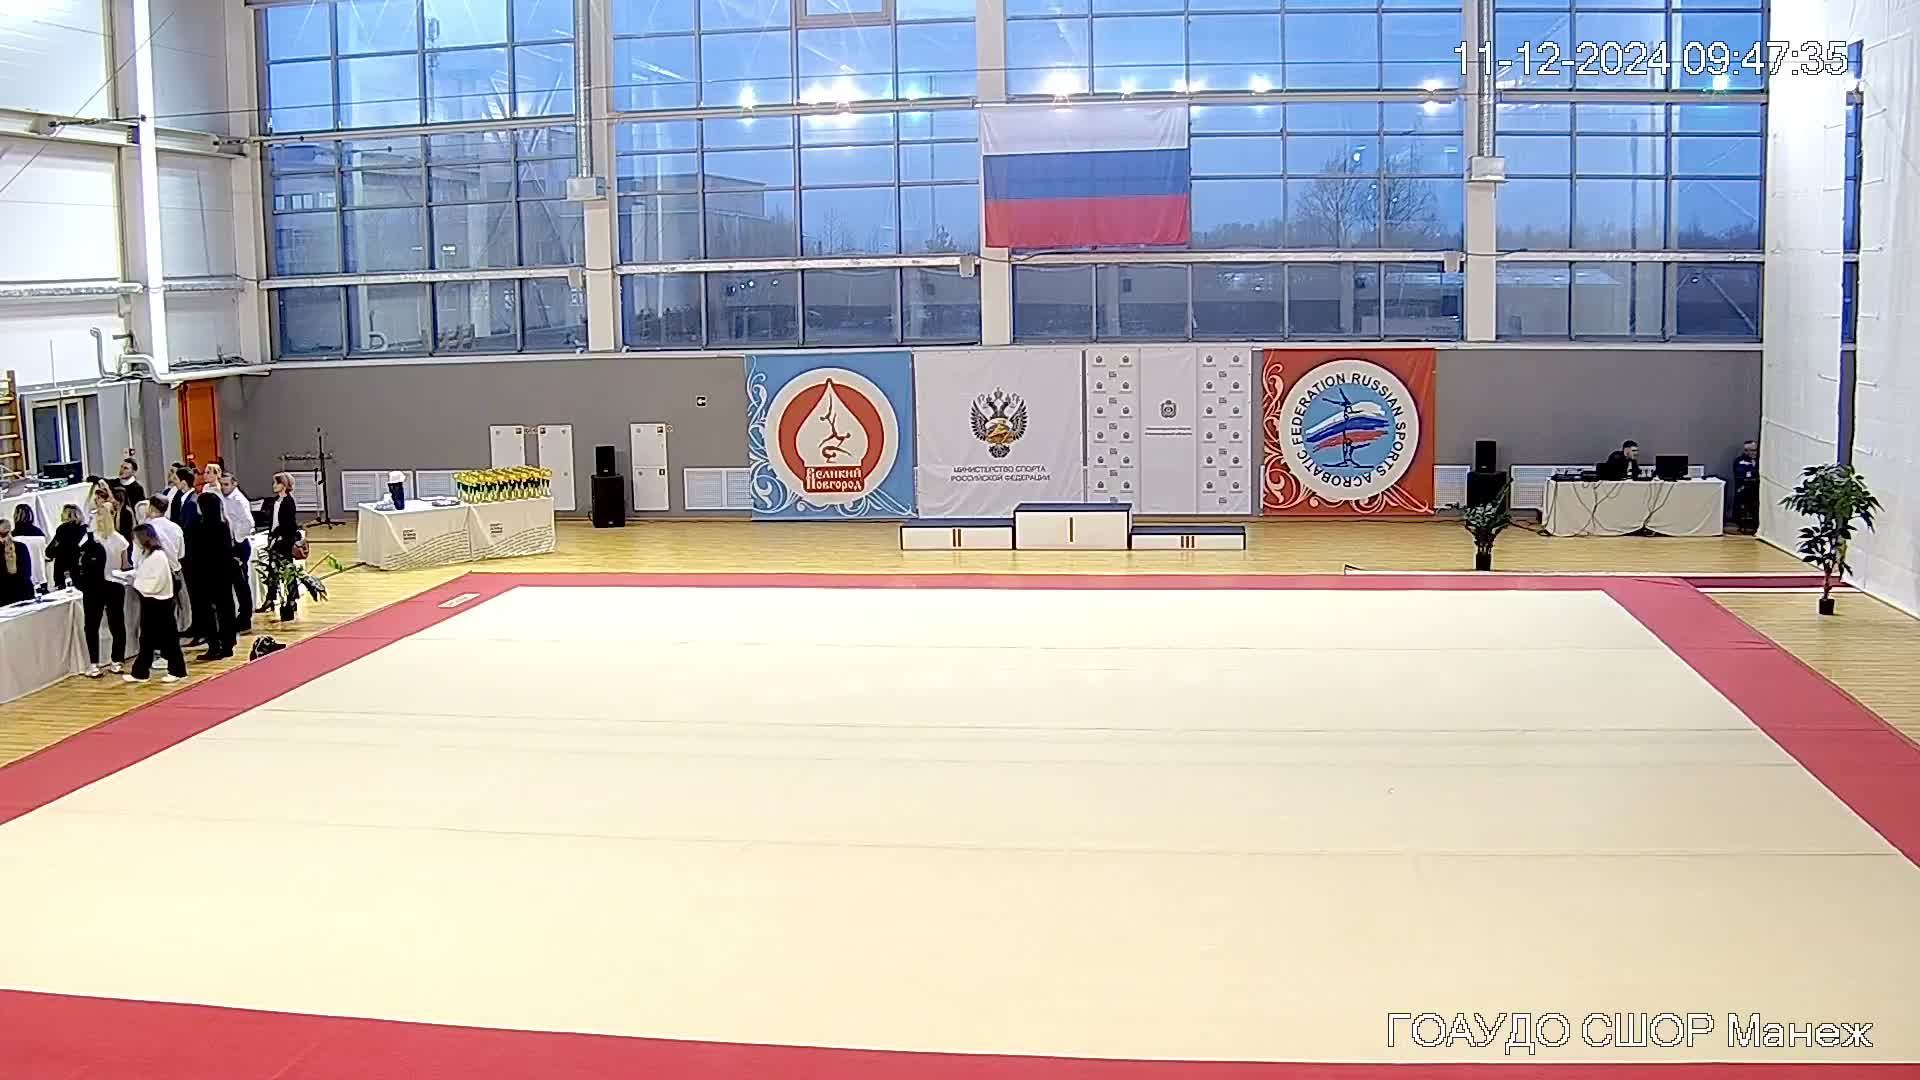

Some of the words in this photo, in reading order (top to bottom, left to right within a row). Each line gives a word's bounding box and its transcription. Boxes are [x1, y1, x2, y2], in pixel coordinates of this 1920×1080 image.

[1291, 373, 1346, 446] FEDERATION
[1351, 373, 1404, 417] RUSSIAN
[1015, 465, 1046, 473] СПОРТА
[1296, 450, 1372, 488] ACROBATIC
[1376, 421, 1406, 476] SPORTS
